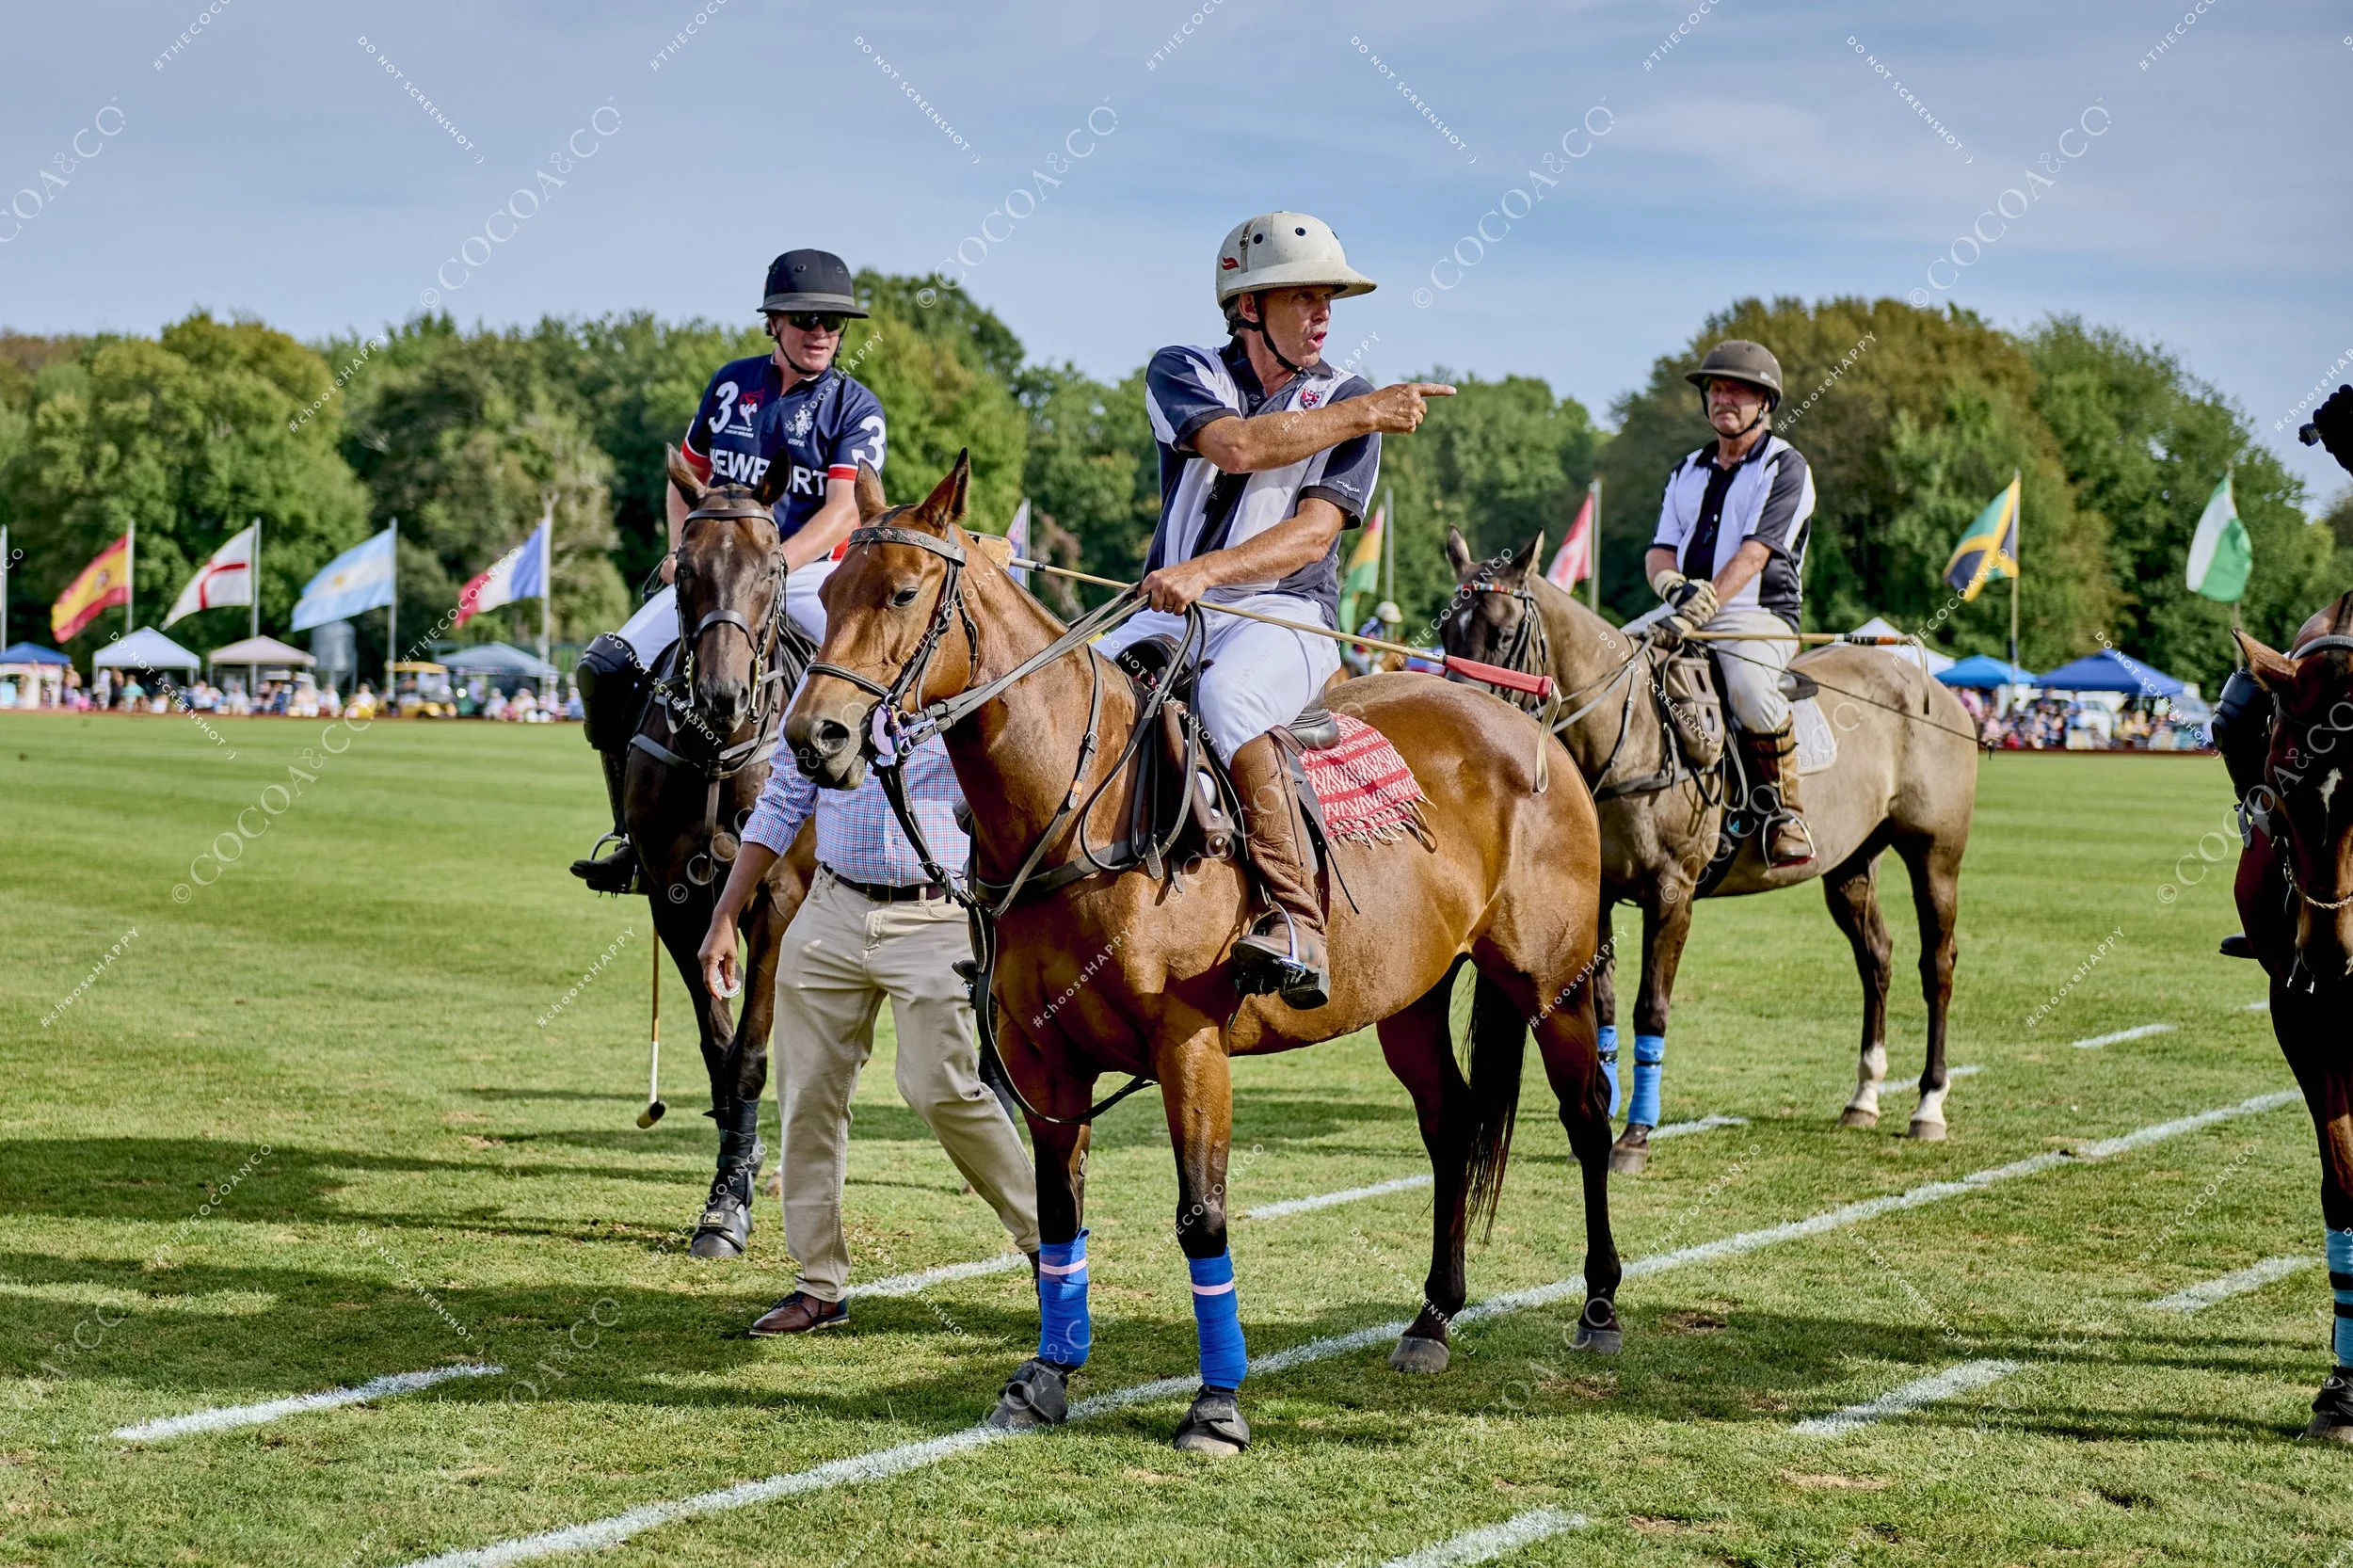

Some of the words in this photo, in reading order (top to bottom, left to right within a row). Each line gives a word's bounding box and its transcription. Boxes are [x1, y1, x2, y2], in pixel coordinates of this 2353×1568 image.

[709, 381, 739, 434] 3
[852, 416, 887, 471] 3
[710, 448, 828, 497] NEWPRT
